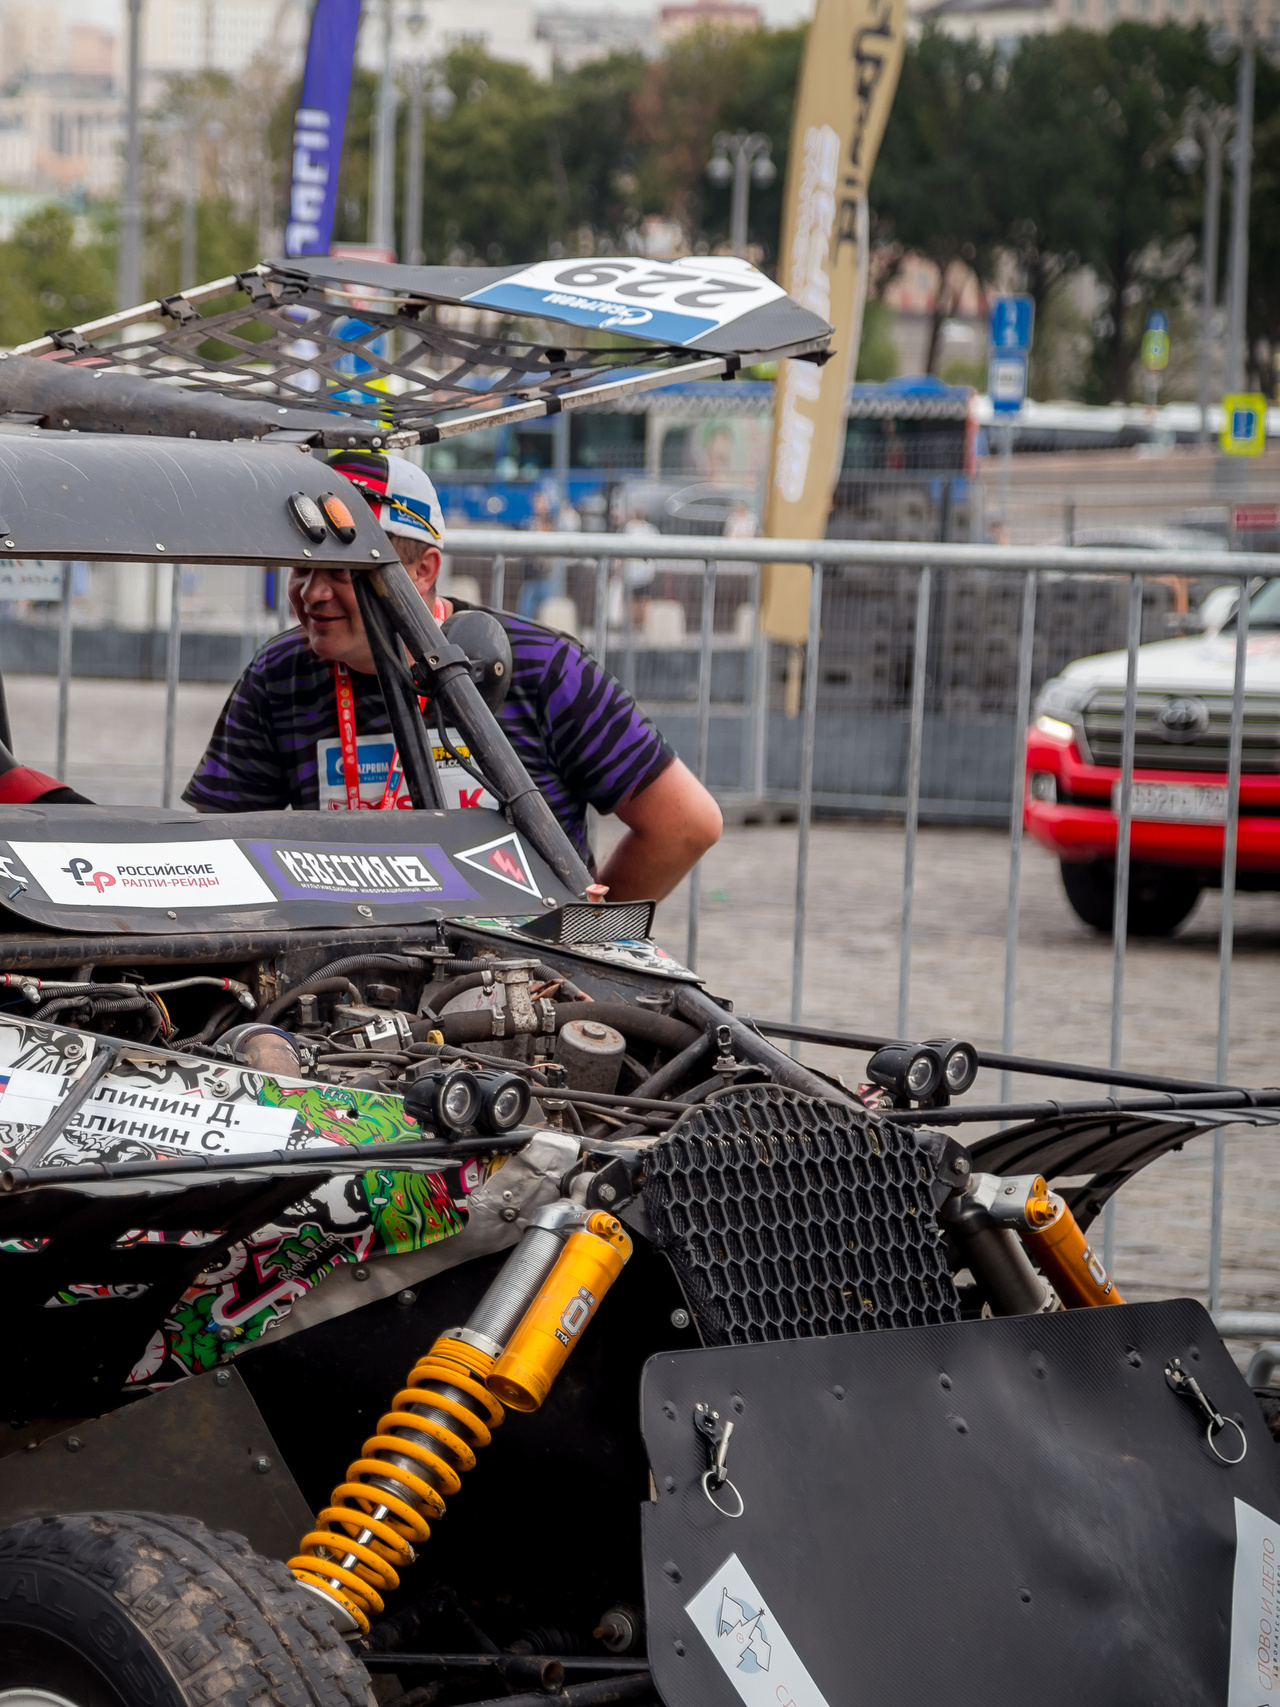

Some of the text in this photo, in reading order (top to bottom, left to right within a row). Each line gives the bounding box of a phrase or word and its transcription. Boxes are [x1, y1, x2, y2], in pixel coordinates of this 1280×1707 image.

[554, 263, 762, 308] 229
[116, 863, 216, 876] РОССИЙСКИЕ
[121, 875, 220, 888] РАЛЛИ-РЕЙДЫ
[276, 850, 400, 888] ИЗВЕСТИЯ
[206, 1102, 241, 1128] Д.
[200, 1130, 231, 1154] С.
[1257, 1537, 1276, 1691] СЛОВО И ДЕЛО
